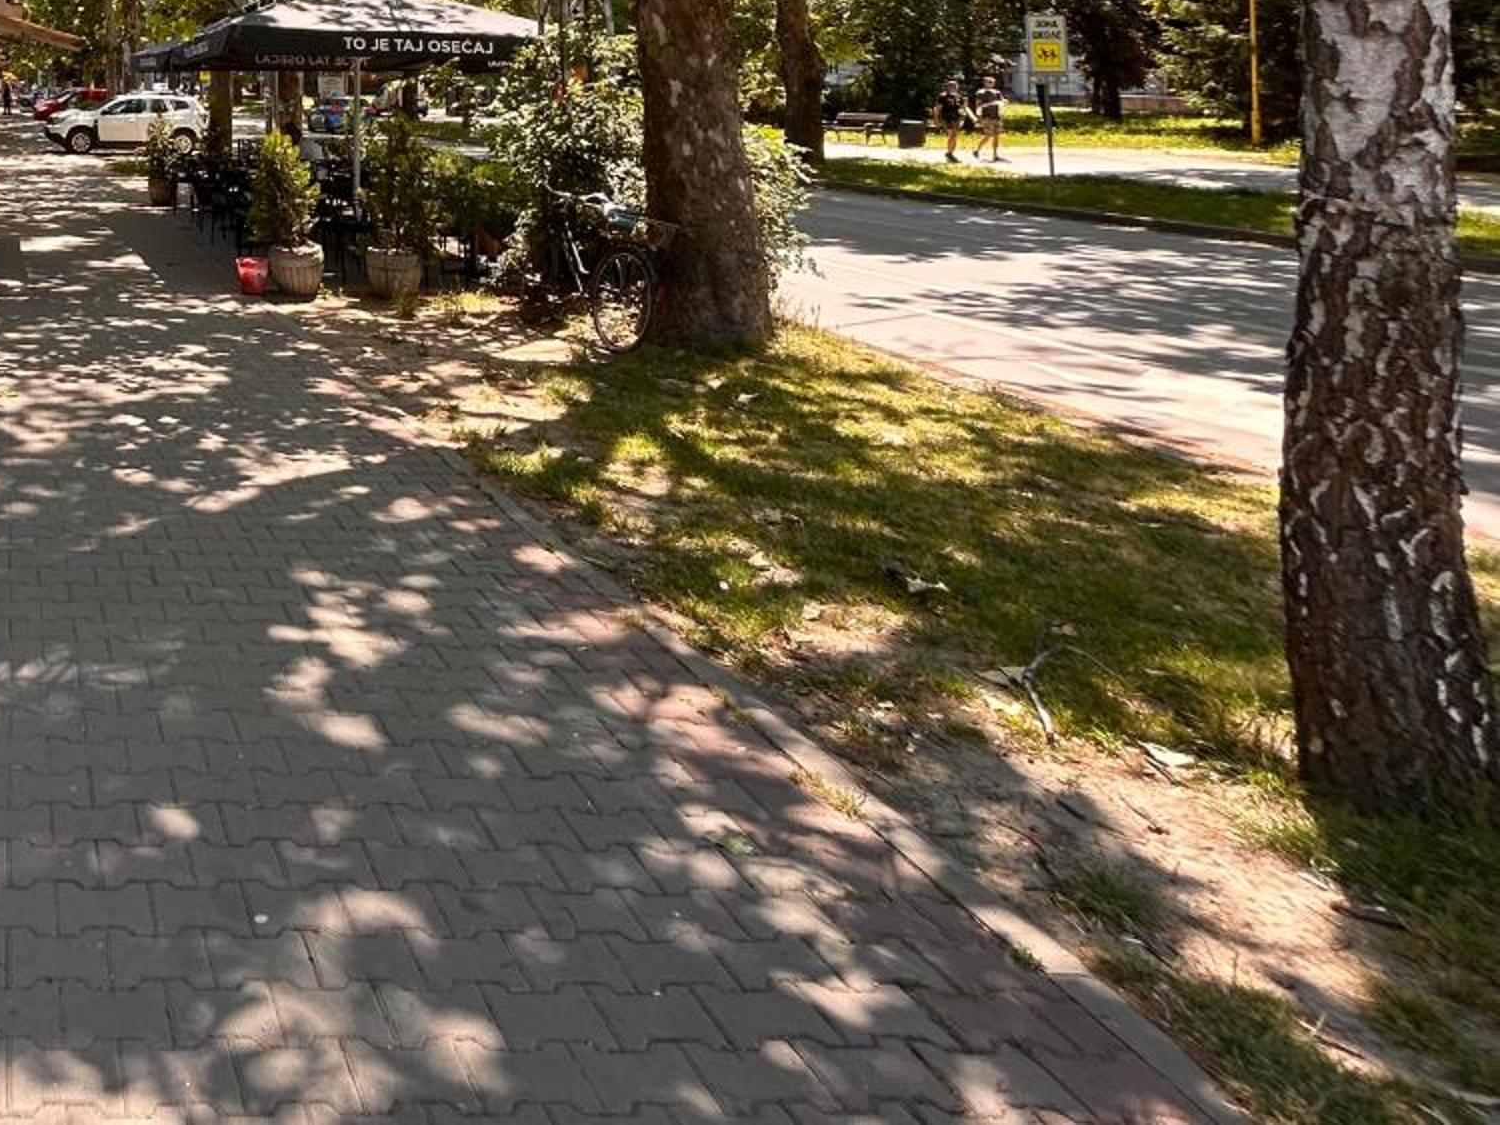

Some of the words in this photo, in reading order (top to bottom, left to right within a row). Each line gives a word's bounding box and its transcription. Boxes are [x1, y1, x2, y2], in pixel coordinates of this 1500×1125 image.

[342, 36, 367, 50] TO
[369, 38, 390, 52] JE
[393, 38, 424, 53] TAJ
